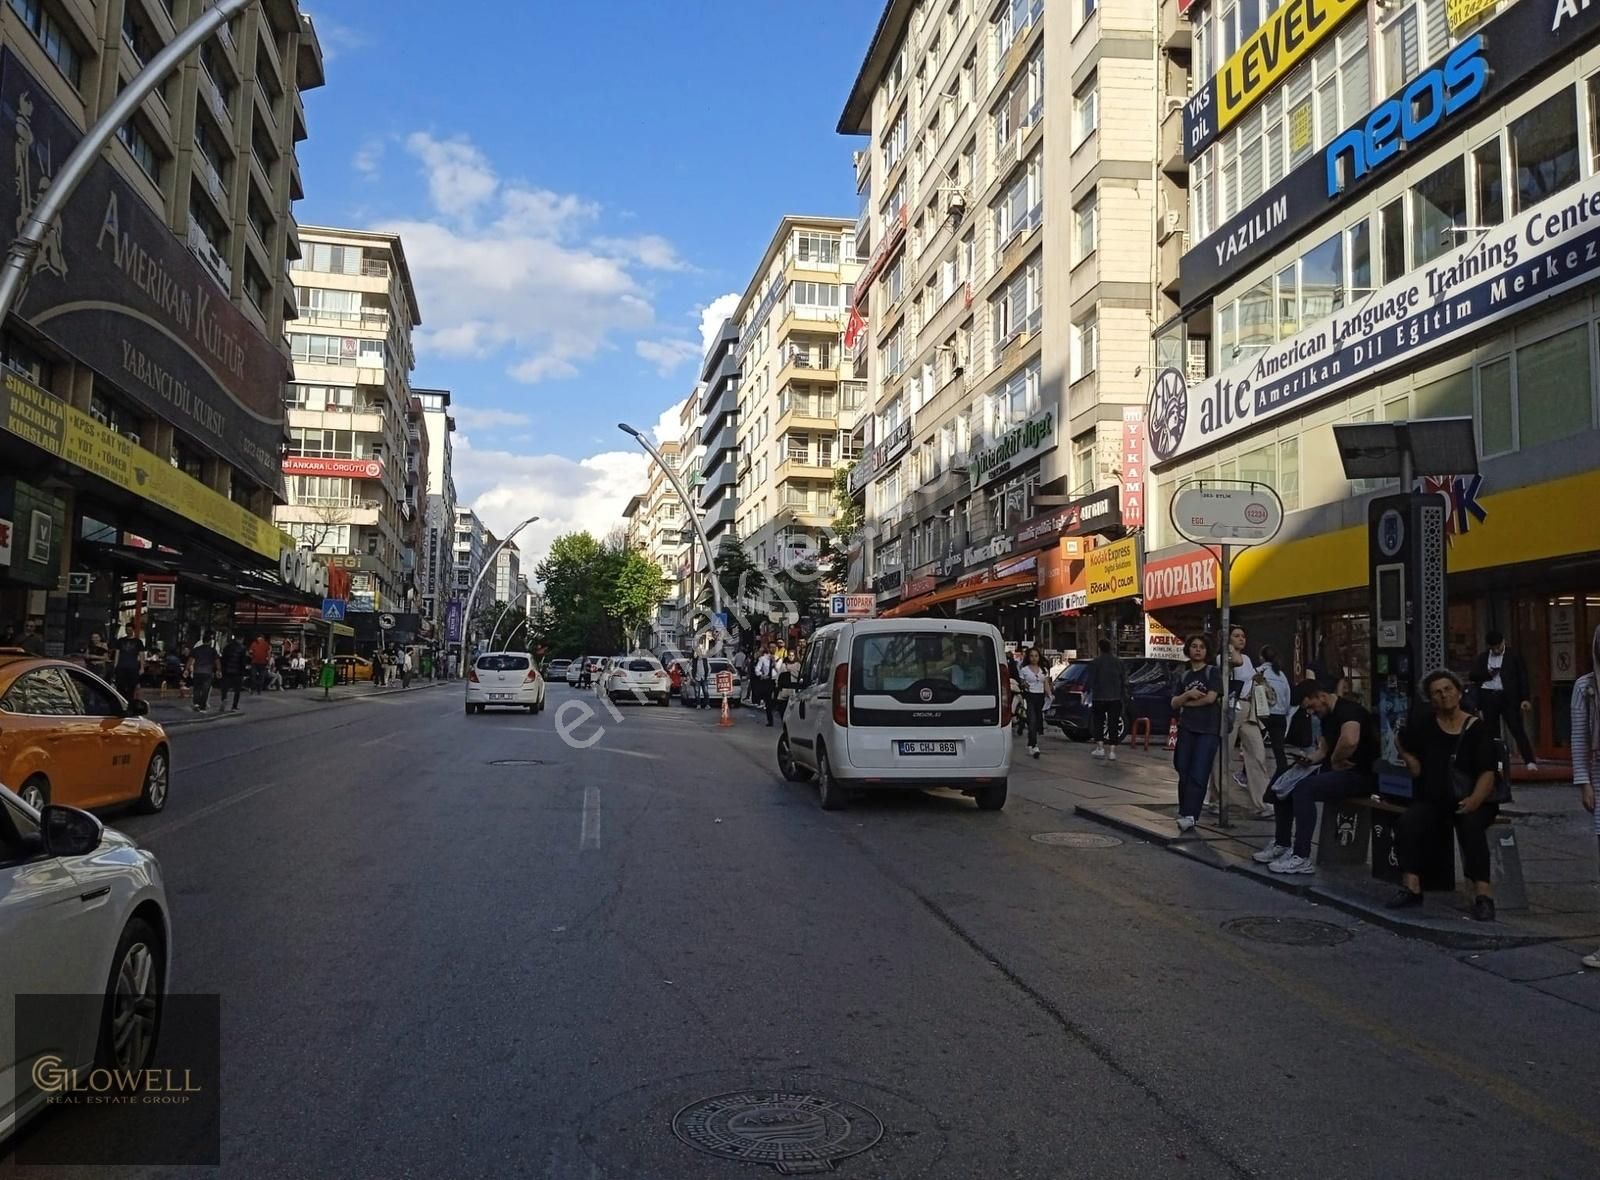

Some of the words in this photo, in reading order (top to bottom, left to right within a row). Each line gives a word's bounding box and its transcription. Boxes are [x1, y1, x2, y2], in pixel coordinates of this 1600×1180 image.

[1225, 0, 1327, 110] LEVEL
[1189, 87, 1210, 120] YKS
[1326, 34, 1489, 198] neos
[1192, 118, 1210, 148] DİL
[1215, 195, 1288, 267] YAZILIM
[1255, 331, 1327, 382] American
[1332, 285, 1420, 346] Language
[1425, 234, 1518, 299] Training
[1258, 359, 1342, 409] Amerikan
[1353, 335, 1383, 367] Dil
[1396, 298, 1472, 346] Eğitim
[1490, 240, 1598, 305] Merkez
[122, 338, 173, 402] YABANCI
[174, 380, 191, 415] DİL
[193, 395, 225, 438] KURSU
[1200, 376, 1251, 436] altc
[293, 461, 325, 471] ANKARA
[1126, 424, 1140, 507] YIKAMA
[1090, 549, 1109, 567] Kodak
[1108, 546, 1131, 561] Express
[1117, 576, 1134, 588] COLOR
[1145, 557, 1216, 601] OTOPARK
[846, 597, 873, 607] OTOPARK
[905, 743, 916, 753] 06
[919, 743, 935, 753] CHJ
[939, 743, 955, 753] 869
